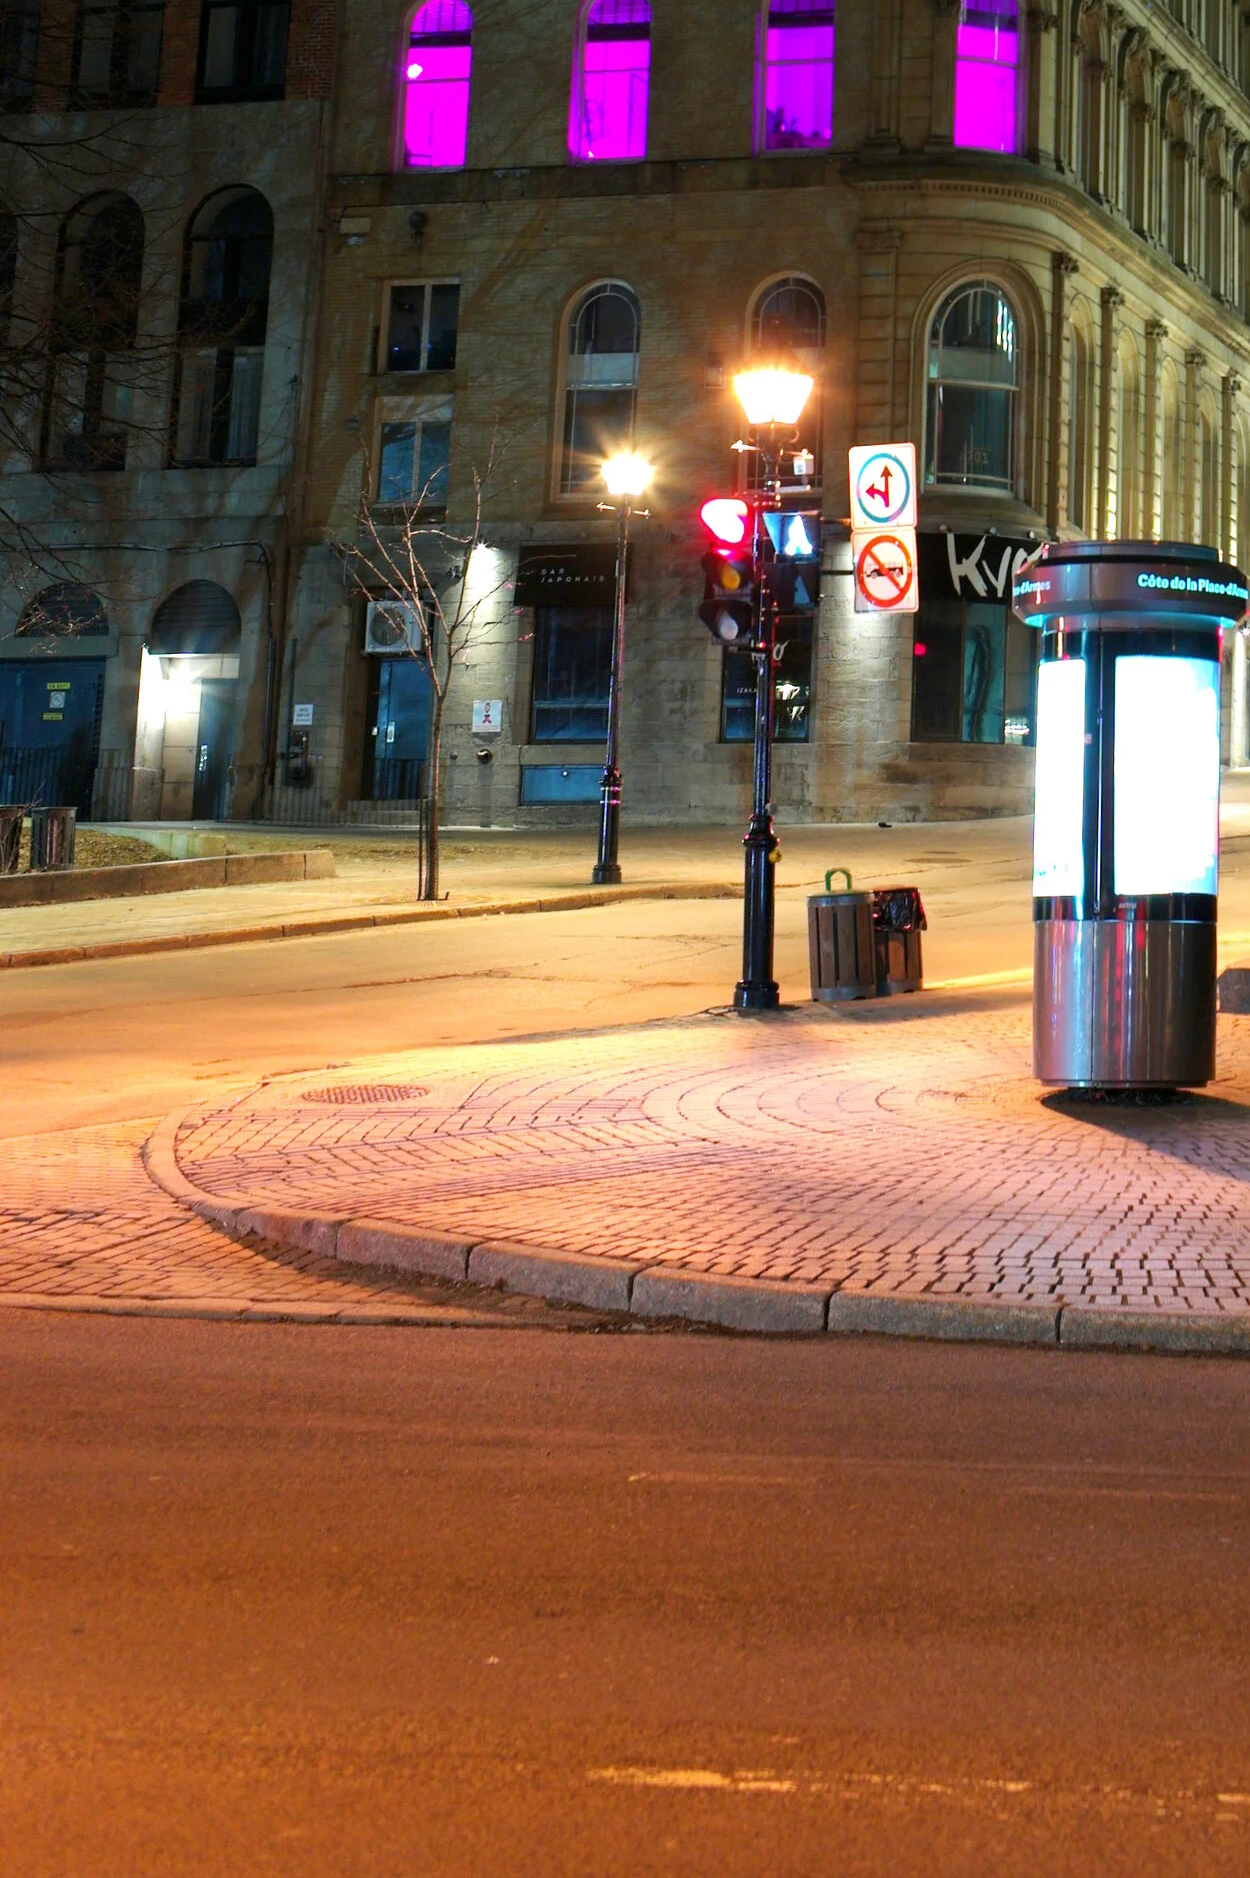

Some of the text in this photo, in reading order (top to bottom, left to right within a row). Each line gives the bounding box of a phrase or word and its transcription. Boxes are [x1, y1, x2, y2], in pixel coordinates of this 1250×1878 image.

[541, 575, 605, 583] JAPONAIS
[1137, 573, 1170, 589] Côte
[1170, 575, 1187, 591] de
[1186, 577, 1199, 592] la
